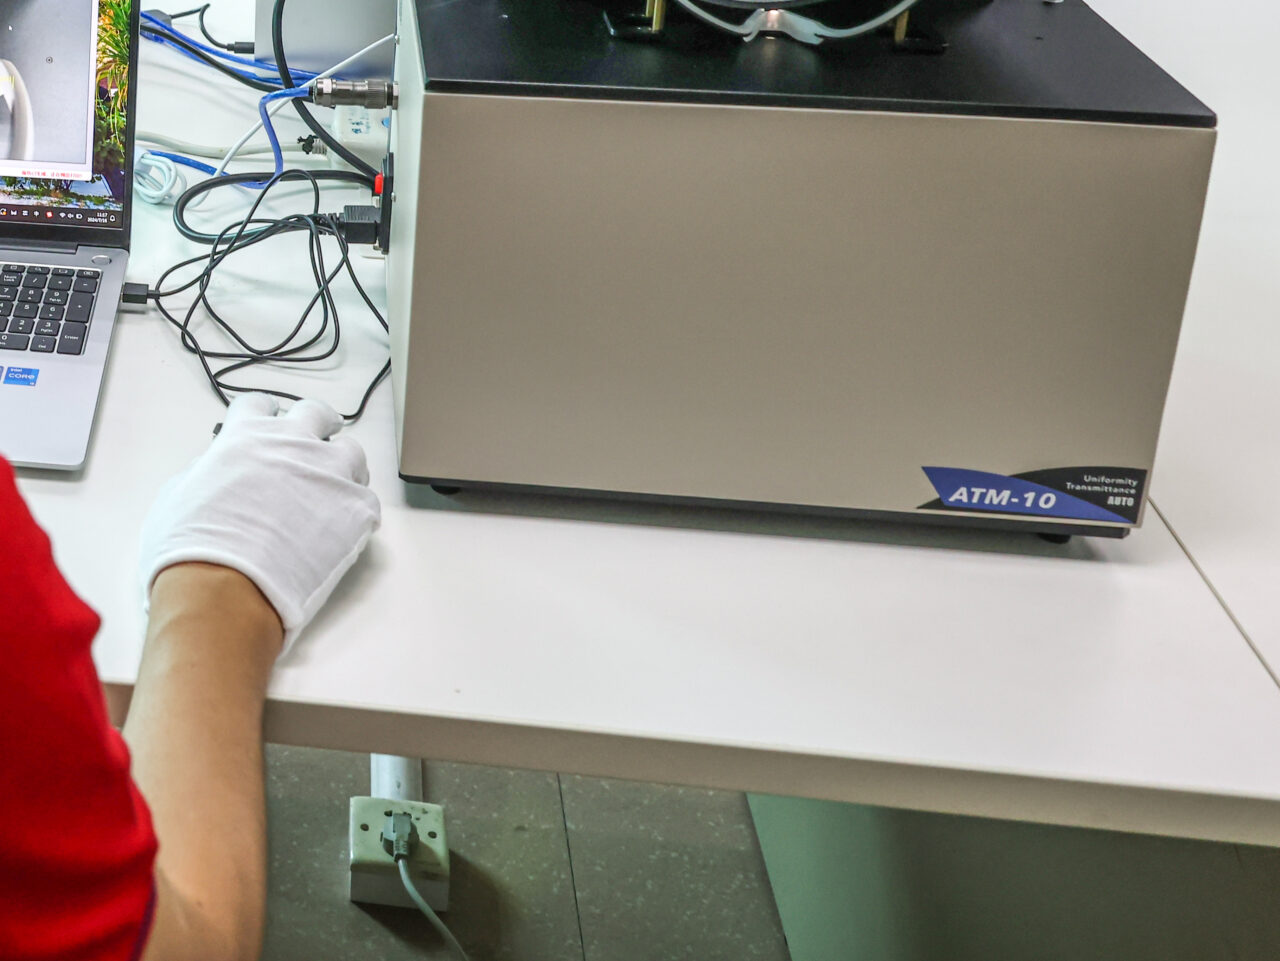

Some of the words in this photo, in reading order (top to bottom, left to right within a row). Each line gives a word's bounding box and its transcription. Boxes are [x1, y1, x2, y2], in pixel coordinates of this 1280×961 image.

[1084, 474, 1138, 487] Uniformity
[1066, 482, 1136, 494] Transmittance
[949, 486, 1056, 509] ATM-10
[1107, 496, 1134, 506] AUTO
